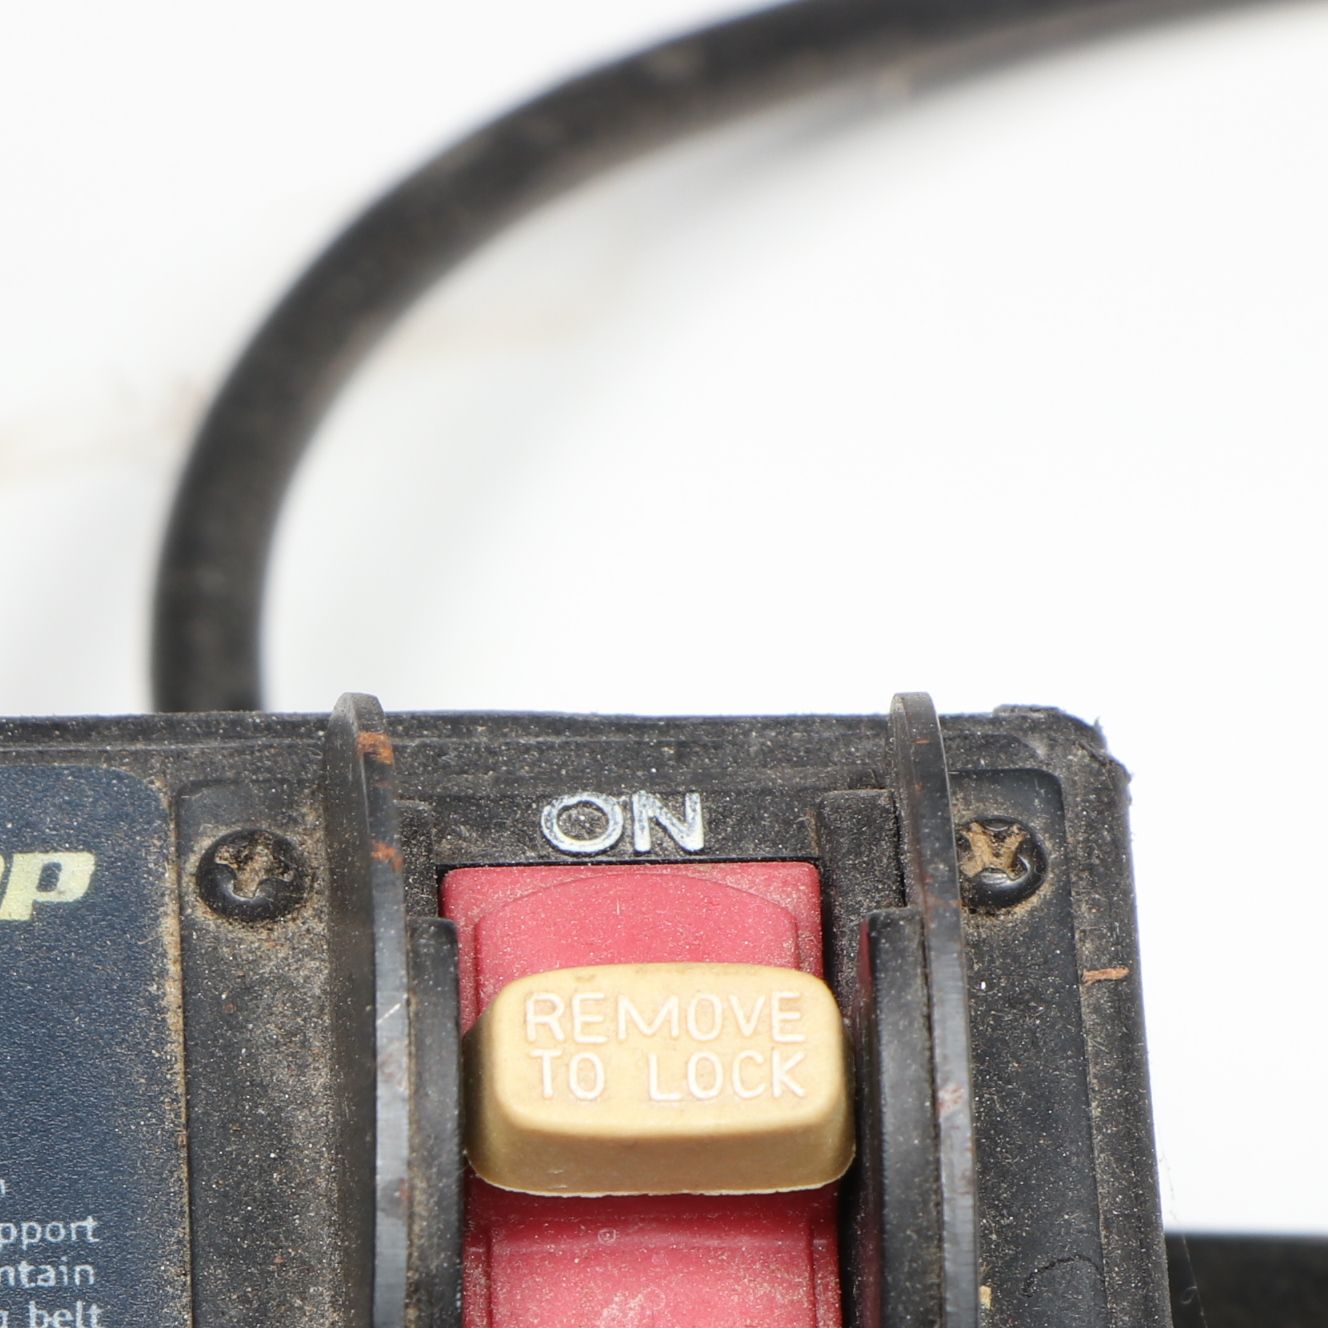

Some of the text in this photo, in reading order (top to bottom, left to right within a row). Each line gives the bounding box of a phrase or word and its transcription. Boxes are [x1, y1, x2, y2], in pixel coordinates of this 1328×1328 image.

[541, 792, 705, 853] ON
[524, 991, 806, 1044] REMOVE
[532, 1049, 806, 1102] TO LOCK
